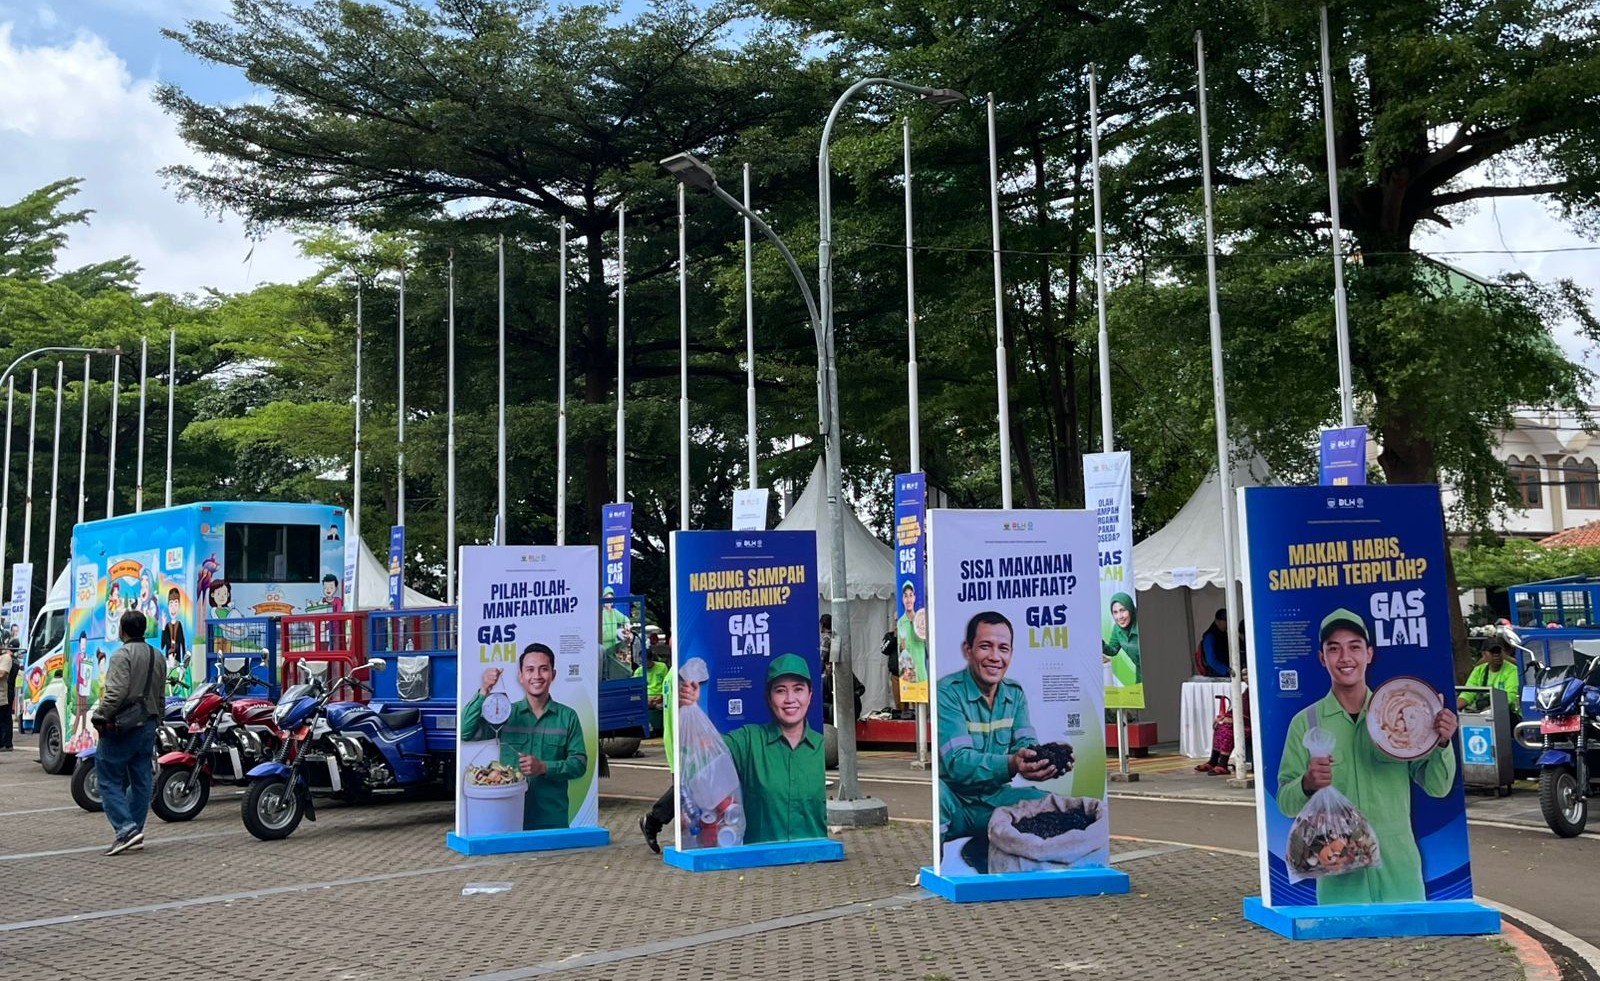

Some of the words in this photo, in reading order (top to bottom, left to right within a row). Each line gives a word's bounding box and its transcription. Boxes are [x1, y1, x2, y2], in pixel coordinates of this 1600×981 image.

[1097, 506, 1119, 516] AMPAH
[1098, 498, 1114, 506] OLAH
[1098, 515, 1119, 524] RGANIK
[1098, 525, 1115, 533] PAKAI
[1098, 533, 1120, 543] OSEDA?
[900, 548, 916, 562] GAS
[1288, 540, 1347, 566] MAKAN
[1353, 537, 1405, 561] HABIS,
[607, 562, 623, 574] GAS
[900, 560, 916, 574] LAH
[960, 558, 994, 580] SISA
[1000, 554, 1072, 577] MAKANAN
[1100, 566, 1123, 582] AH
[1269, 566, 1338, 591] SAMPAH
[1344, 558, 1427, 585] TERPILAH?
[608, 572, 623, 584] LAH
[689, 570, 744, 592] NABUNG
[748, 565, 805, 587] SAMPAH
[958, 580, 992, 602] JADI
[997, 575, 1076, 600] MANFAAT?
[491, 580, 571, 600] PILAH-OLAH-
[706, 585, 790, 611] ANORGANIK?
[483, 598, 578, 619] MANFAATKAN?
[1370, 588, 1426, 621] GAS
[729, 611, 770, 636] GAS
[1026, 603, 1068, 629] GAS
[478, 622, 517, 644] GAS
[1029, 626, 1068, 649] LAH
[1374, 616, 1429, 648] LAH
[480, 642, 516, 663] LAH
[731, 633, 770, 656] LAH
